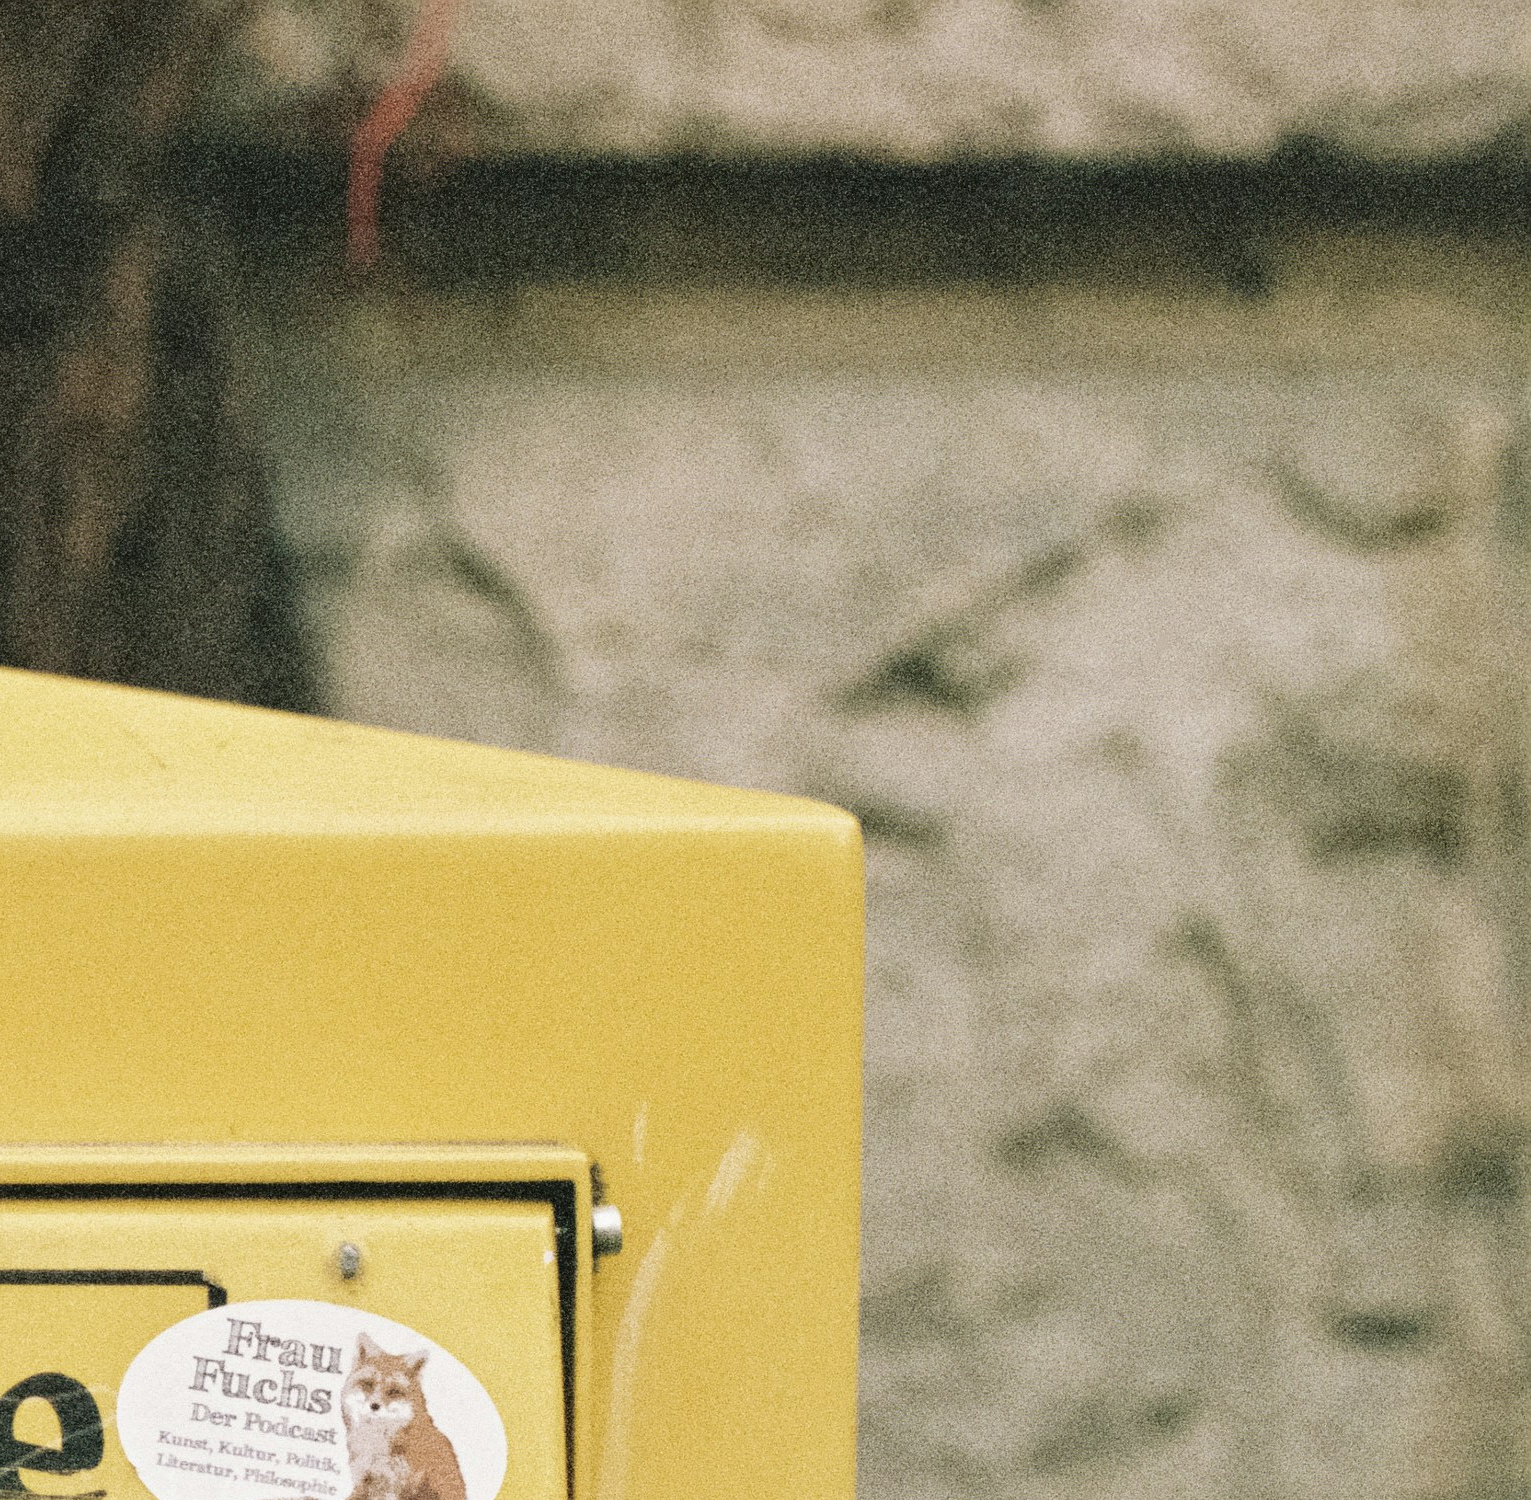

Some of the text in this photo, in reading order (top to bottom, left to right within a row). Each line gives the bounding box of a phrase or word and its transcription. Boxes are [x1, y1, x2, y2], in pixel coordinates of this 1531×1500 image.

[223, 1317, 343, 1375] Frau
[188, 1355, 333, 1415] Fuchs
[190, 1402, 338, 1445] Der Podcast
[156, 1452, 338, 1496] Literatur, Philosophie
[157, 1430, 341, 1476] Kunst, Kultur, Politik,
